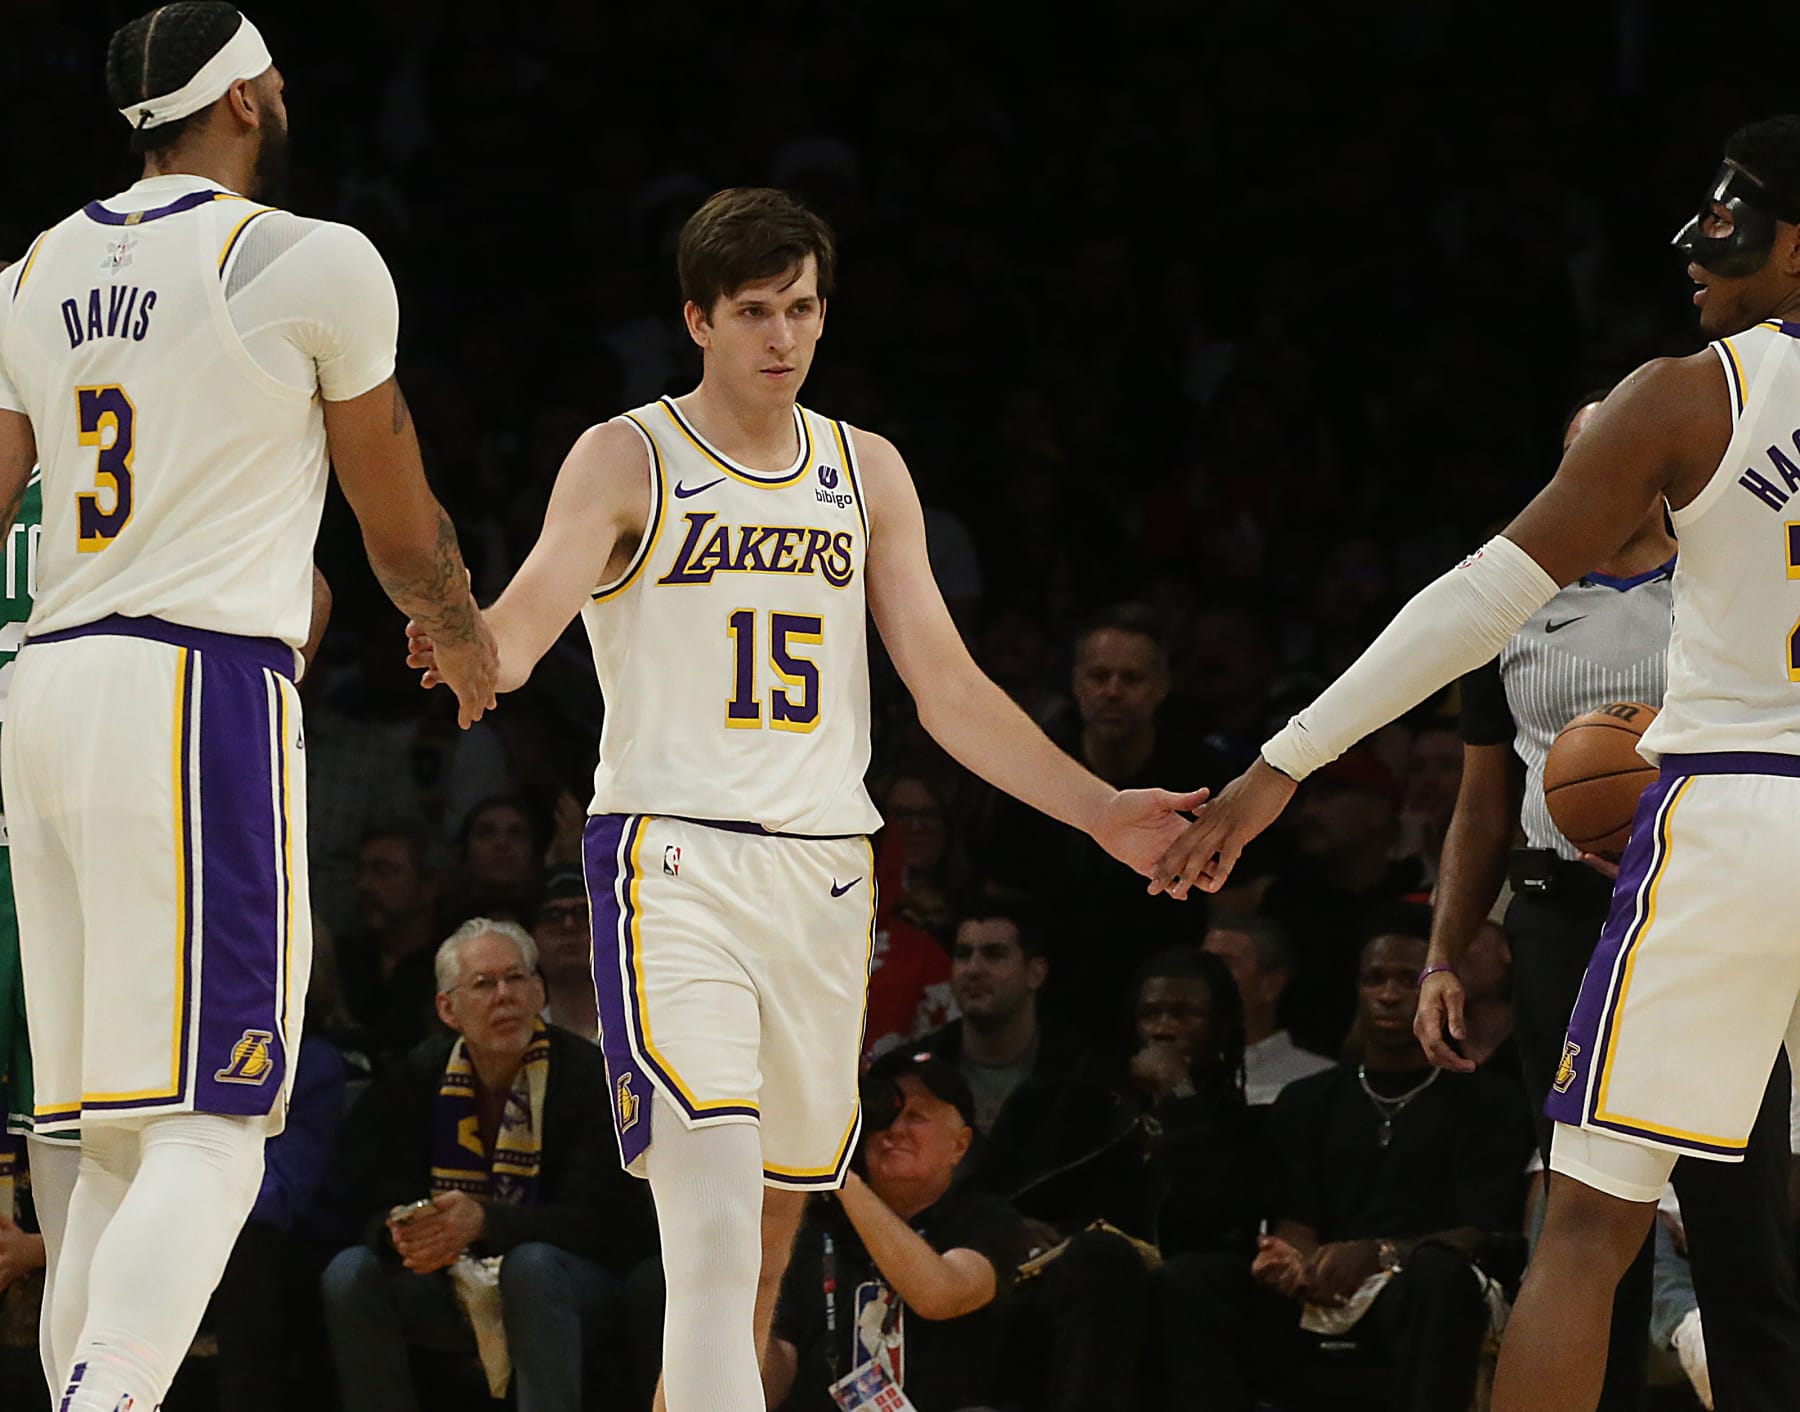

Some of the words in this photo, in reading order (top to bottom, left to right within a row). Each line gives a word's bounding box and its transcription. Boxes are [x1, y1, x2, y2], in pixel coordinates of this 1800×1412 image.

[61, 285, 157, 350] DAVIS
[75, 383, 137, 553] 3
[815, 488, 853, 509] bibigo
[655, 511, 855, 590] LAKERS
[724, 608, 824, 733] 15
